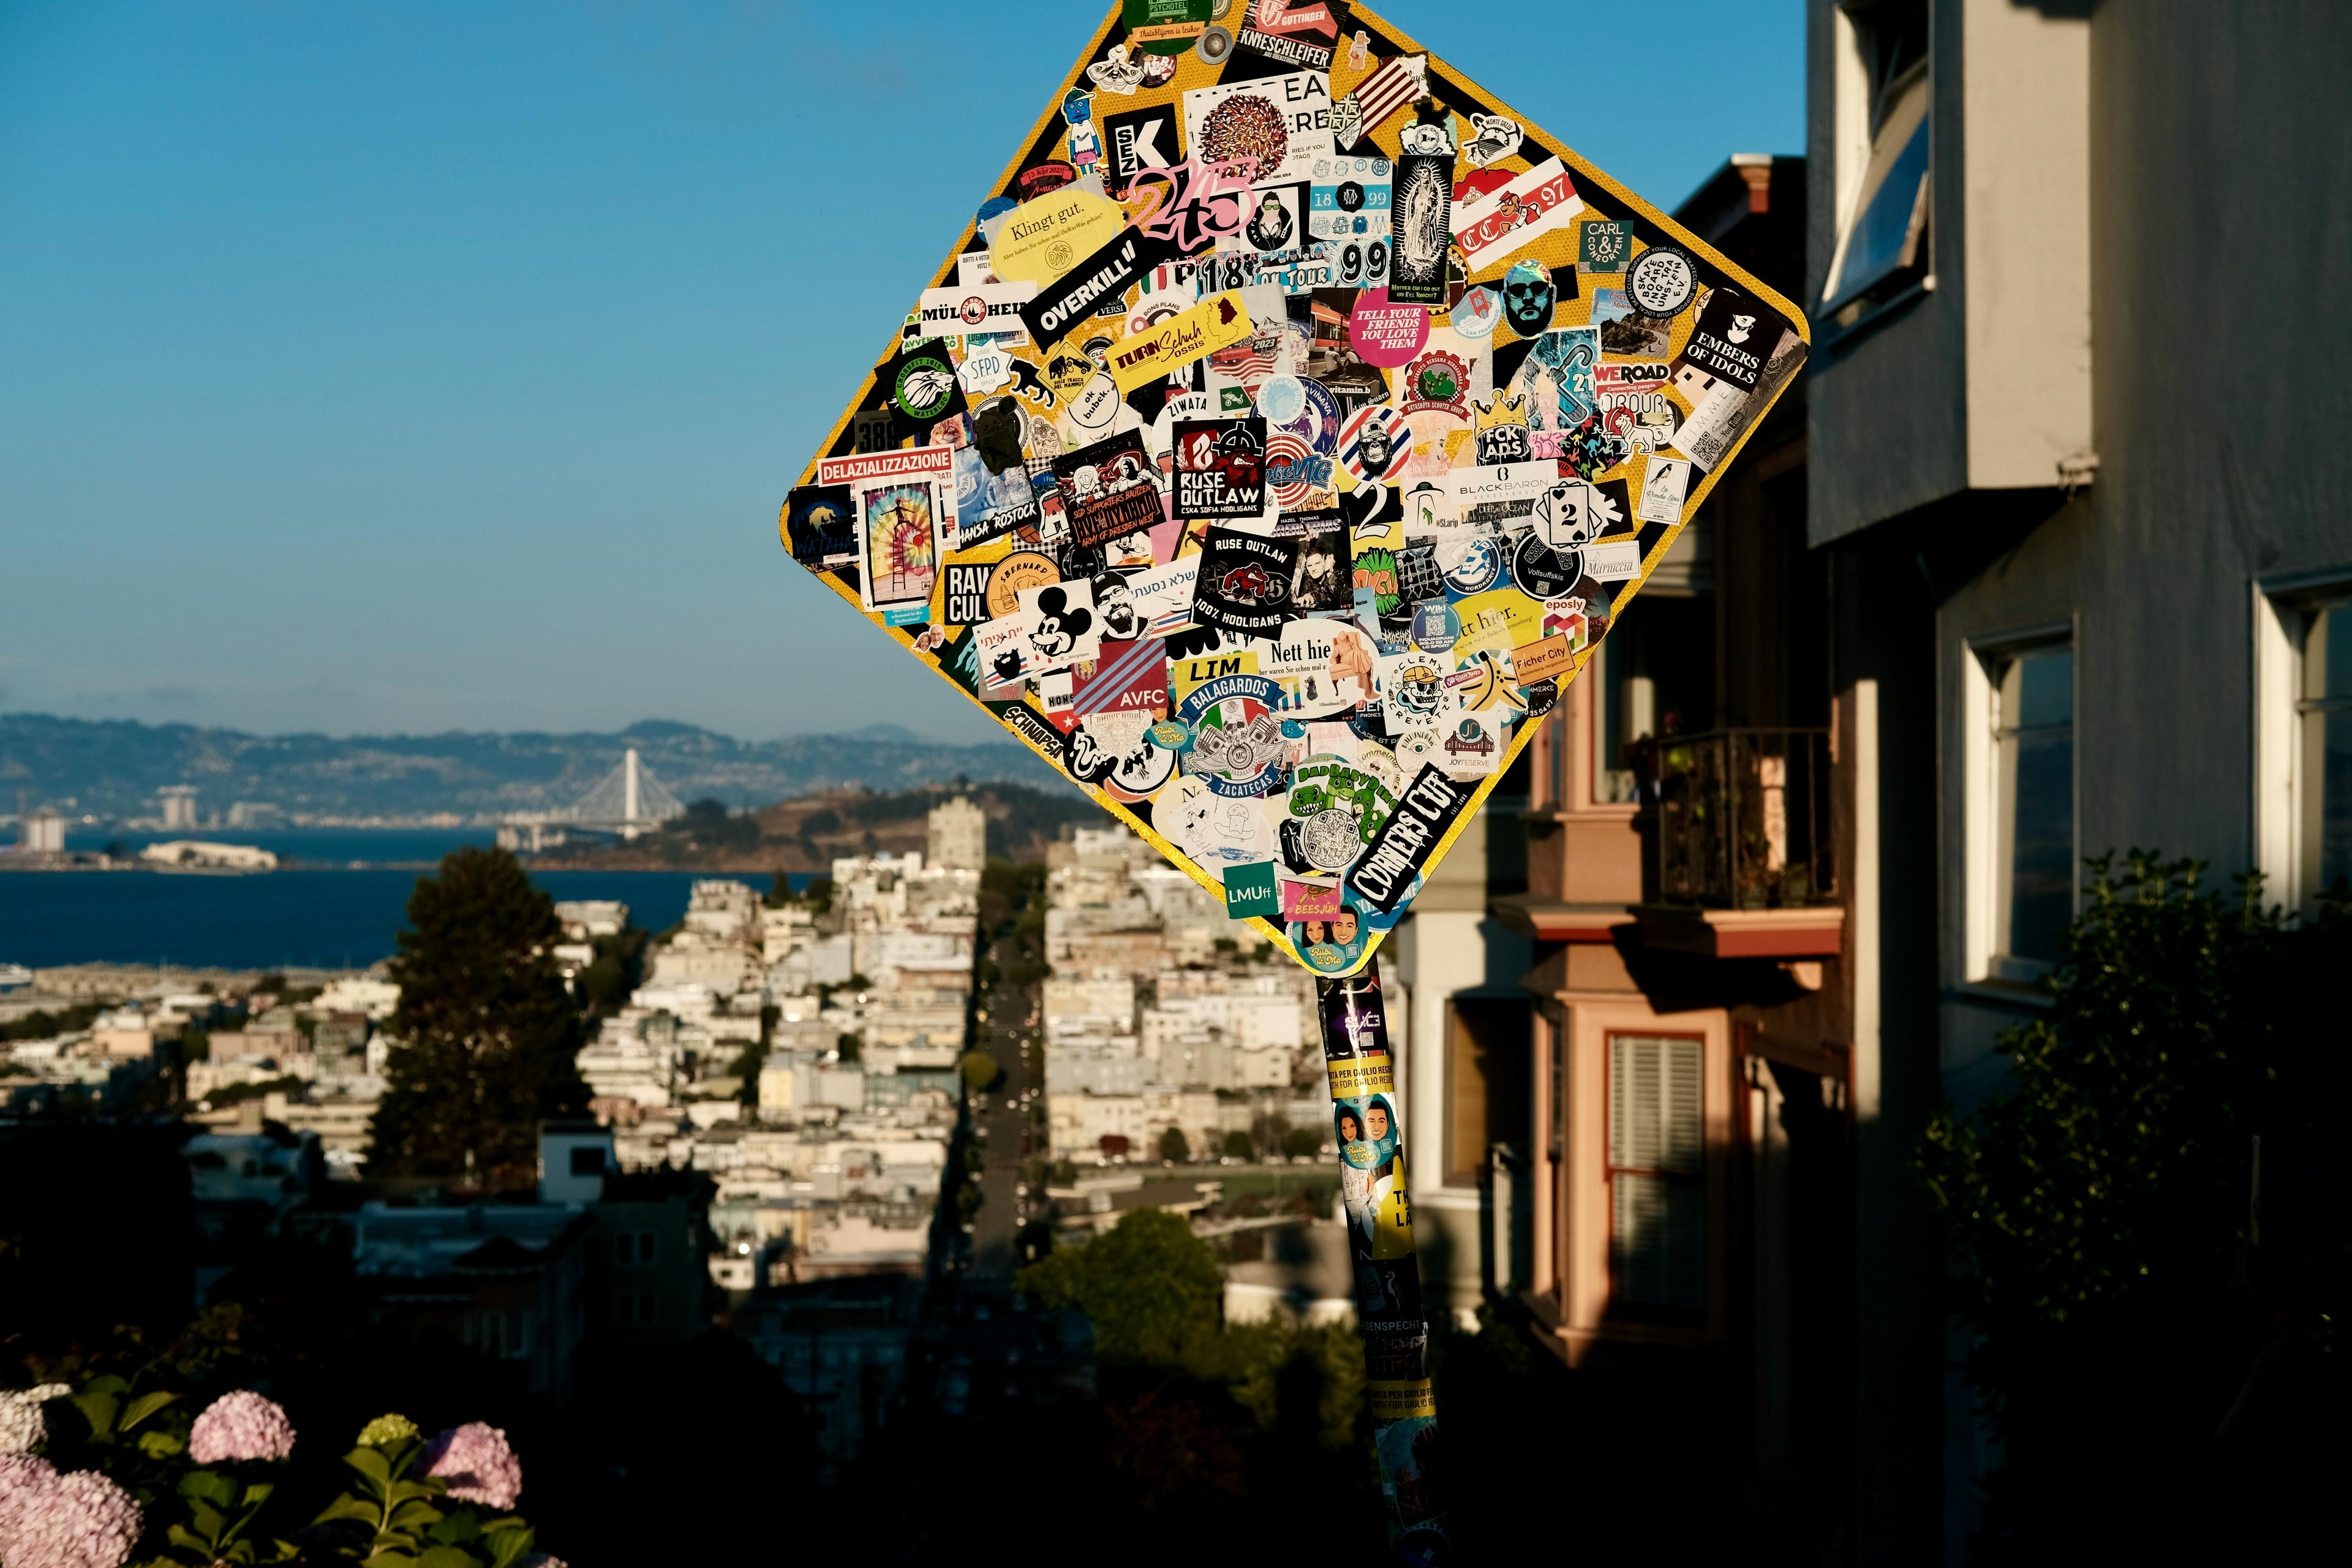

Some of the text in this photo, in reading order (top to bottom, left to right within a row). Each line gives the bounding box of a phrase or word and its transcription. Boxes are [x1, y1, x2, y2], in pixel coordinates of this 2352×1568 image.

[1150, 2, 1186, 12] PSYCHOTEL
[1139, 27, 1174, 37] Thuisblijven
[1314, 193, 1332, 206] 18
[1368, 192, 1386, 206] 99
[1011, 202, 1085, 241] Klingt gut.
[1003, 252, 1014, 261] Aber
[1014, 245, 1028, 256] haben
[1037, 234, 1050, 245] schon
[1051, 231, 1060, 240] mal
[1061, 218, 1087, 236] DaWarWas
[1086, 211, 1104, 226] gehört?
[1588, 222, 1624, 263] CARL & CONSORTEN
[1287, 241, 1389, 287] TOUR 99
[1630, 249, 1651, 271] SUPPORT
[1668, 247, 1686, 258] LOCAL
[1638, 259, 1657, 290] SKATE
[1642, 260, 1665, 298] BOARD
[1648, 260, 1674, 304] ING TRA
[1657, 262, 1681, 307] UNSTEIN
[1673, 281, 1687, 297] E.V.
[1040, 257, 1133, 331] OVERKILL
[1100, 304, 1123, 315] VERSI
[1143, 302, 1181, 317] BONS PLANS
[1638, 304, 1656, 317] LOCAL
[1673, 292, 1695, 315] SUPPORT
[922, 304, 960, 322] MÜL
[1357, 307, 1421, 320] TELL YOUR
[1478, 309, 1499, 334] FRANCISCO
[1368, 318, 1420, 330] FRIENDS
[1361, 328, 1419, 340] YOU LOVE
[1174, 340, 1205, 358] ossis
[1254, 338, 1275, 349] 2023
[1380, 338, 1416, 349] THEM
[1696, 331, 1760, 370] EMBERS
[897, 359, 924, 388] CROSSFIT
[1687, 345, 1709, 361] OF
[1709, 355, 1757, 385] IDOLS
[1083, 389, 1110, 420] bubek.
[1084, 390, 1095, 403] ok
[914, 396, 949, 418] WATERLOO
[1450, 405, 1464, 415] GROUP
[1486, 426, 1520, 443] FCK
[1485, 440, 1522, 458] ADS
[823, 451, 950, 481] DELAZIALIZZAZIONE
[1180, 472, 1225, 489] RUSE
[1073, 484, 1152, 519] SGD SUPPORTERS BAUTZEN
[1180, 488, 1259, 507] OUTLAW
[991, 501, 1038, 530] ROSTOCK
[1220, 505, 1257, 513] HOOLIGANS
[1478, 503, 1529, 514] DEEP OCEAN
[1561, 503, 1577, 526] 2
[1082, 513, 1155, 548] ARMY DRESDEN WEST
[1215, 539, 1288, 564] RUSE OUTLAW
[1000, 562, 1048, 584] SBERNARD
[1528, 568, 1564, 581] Vollsuffskis
[1588, 562, 1633, 576] Mariuccia
[1170, 570, 1196, 587] שלא
[1464, 567, 1496, 592] NORDKURVE
[1195, 598, 1281, 627] 100% HOOLIGANS
[1546, 600, 1583, 611] eposly
[1271, 642, 1302, 663] Nett
[1547, 647, 1566, 660] City
[1190, 657, 1241, 682] LIM
[999, 687, 1020, 699] BW
[1120, 689, 1165, 707] AVFC
[1189, 677, 1270, 710] BALAGARDOS
[1155, 725, 1175, 735] Rubi
[1351, 720, 1376, 742] TULARE
[1218, 774, 1274, 796] ZACATECAS
[1352, 810, 1433, 902] CORNERS
[1229, 886, 1272, 903] LMUff
[1311, 947, 1333, 957] Rubi
[1325, 956, 1342, 965] Mo
[1339, 1069, 1352, 1078] PER
[1340, 1079, 1353, 1088] FOR
